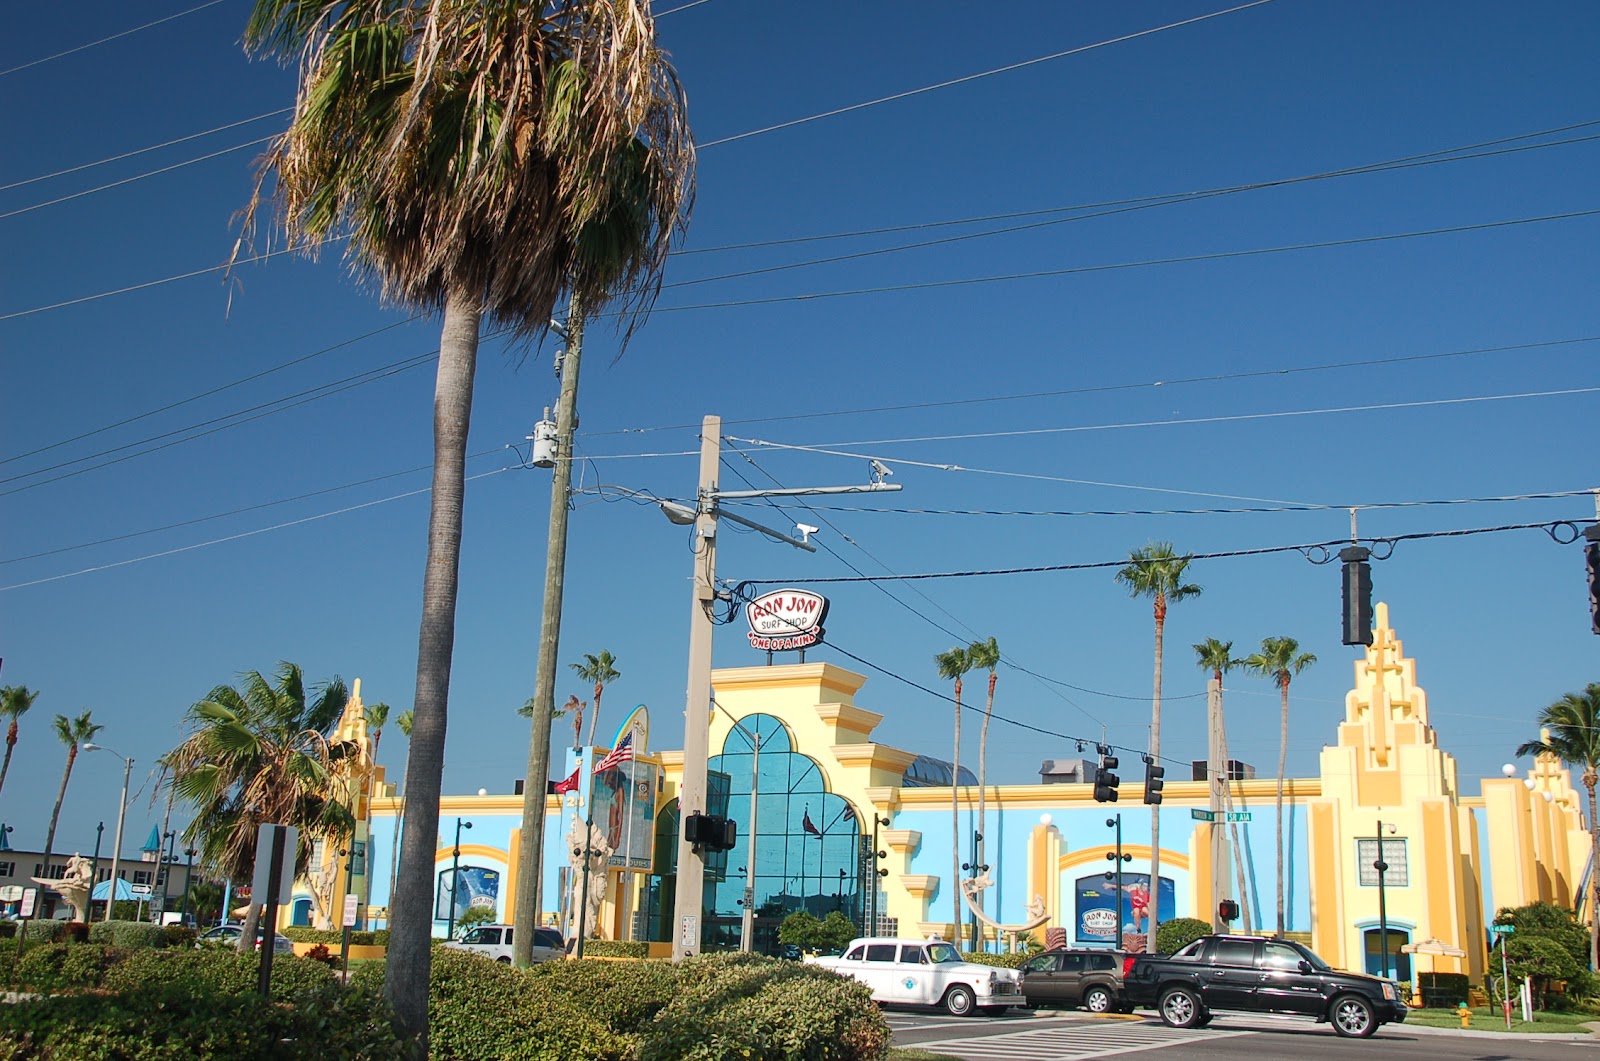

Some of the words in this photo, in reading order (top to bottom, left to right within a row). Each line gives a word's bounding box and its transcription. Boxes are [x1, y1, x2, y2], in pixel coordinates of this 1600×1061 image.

[754, 597, 783, 621] RON
[786, 597, 817, 614] JON
[762, 620, 781, 630] SURF
[785, 617, 808, 628] SHOP
[752, 638, 770, 649] ONE
[771, 639, 784, 649] OF
[785, 638, 792, 647] A
[793, 633, 816, 646] KIND
[1229, 812, 1237, 821] SR
[1239, 812, 1251, 821] A1A
[744, 898, 752, 907] 35
[1086, 911, 1101, 921] RON
[1102, 912, 1118, 921] JON
